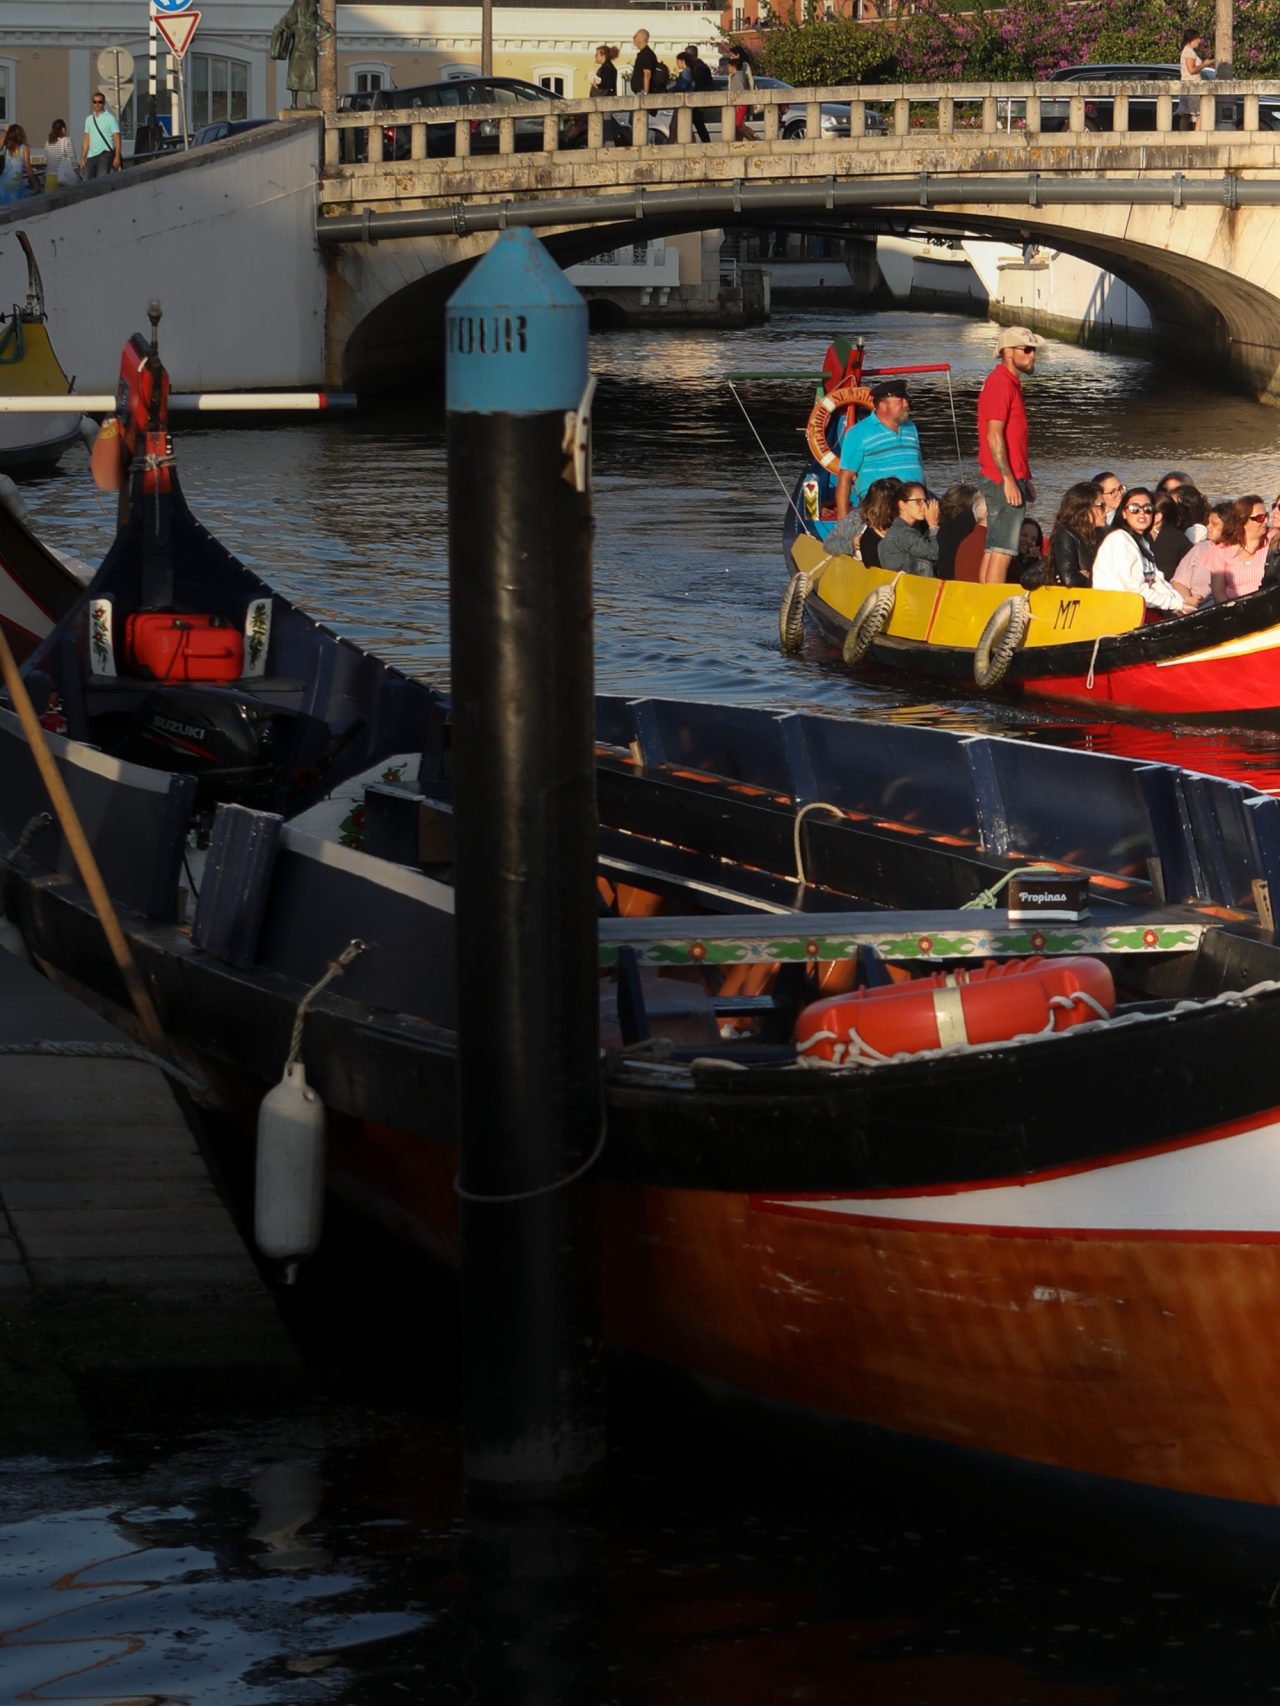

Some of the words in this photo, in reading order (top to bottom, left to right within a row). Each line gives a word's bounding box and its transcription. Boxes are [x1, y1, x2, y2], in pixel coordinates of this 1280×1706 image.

[1054, 600, 1081, 629] MT
[153, 715, 206, 740] SUZUKI
[1019, 892, 1067, 904] Propinas
